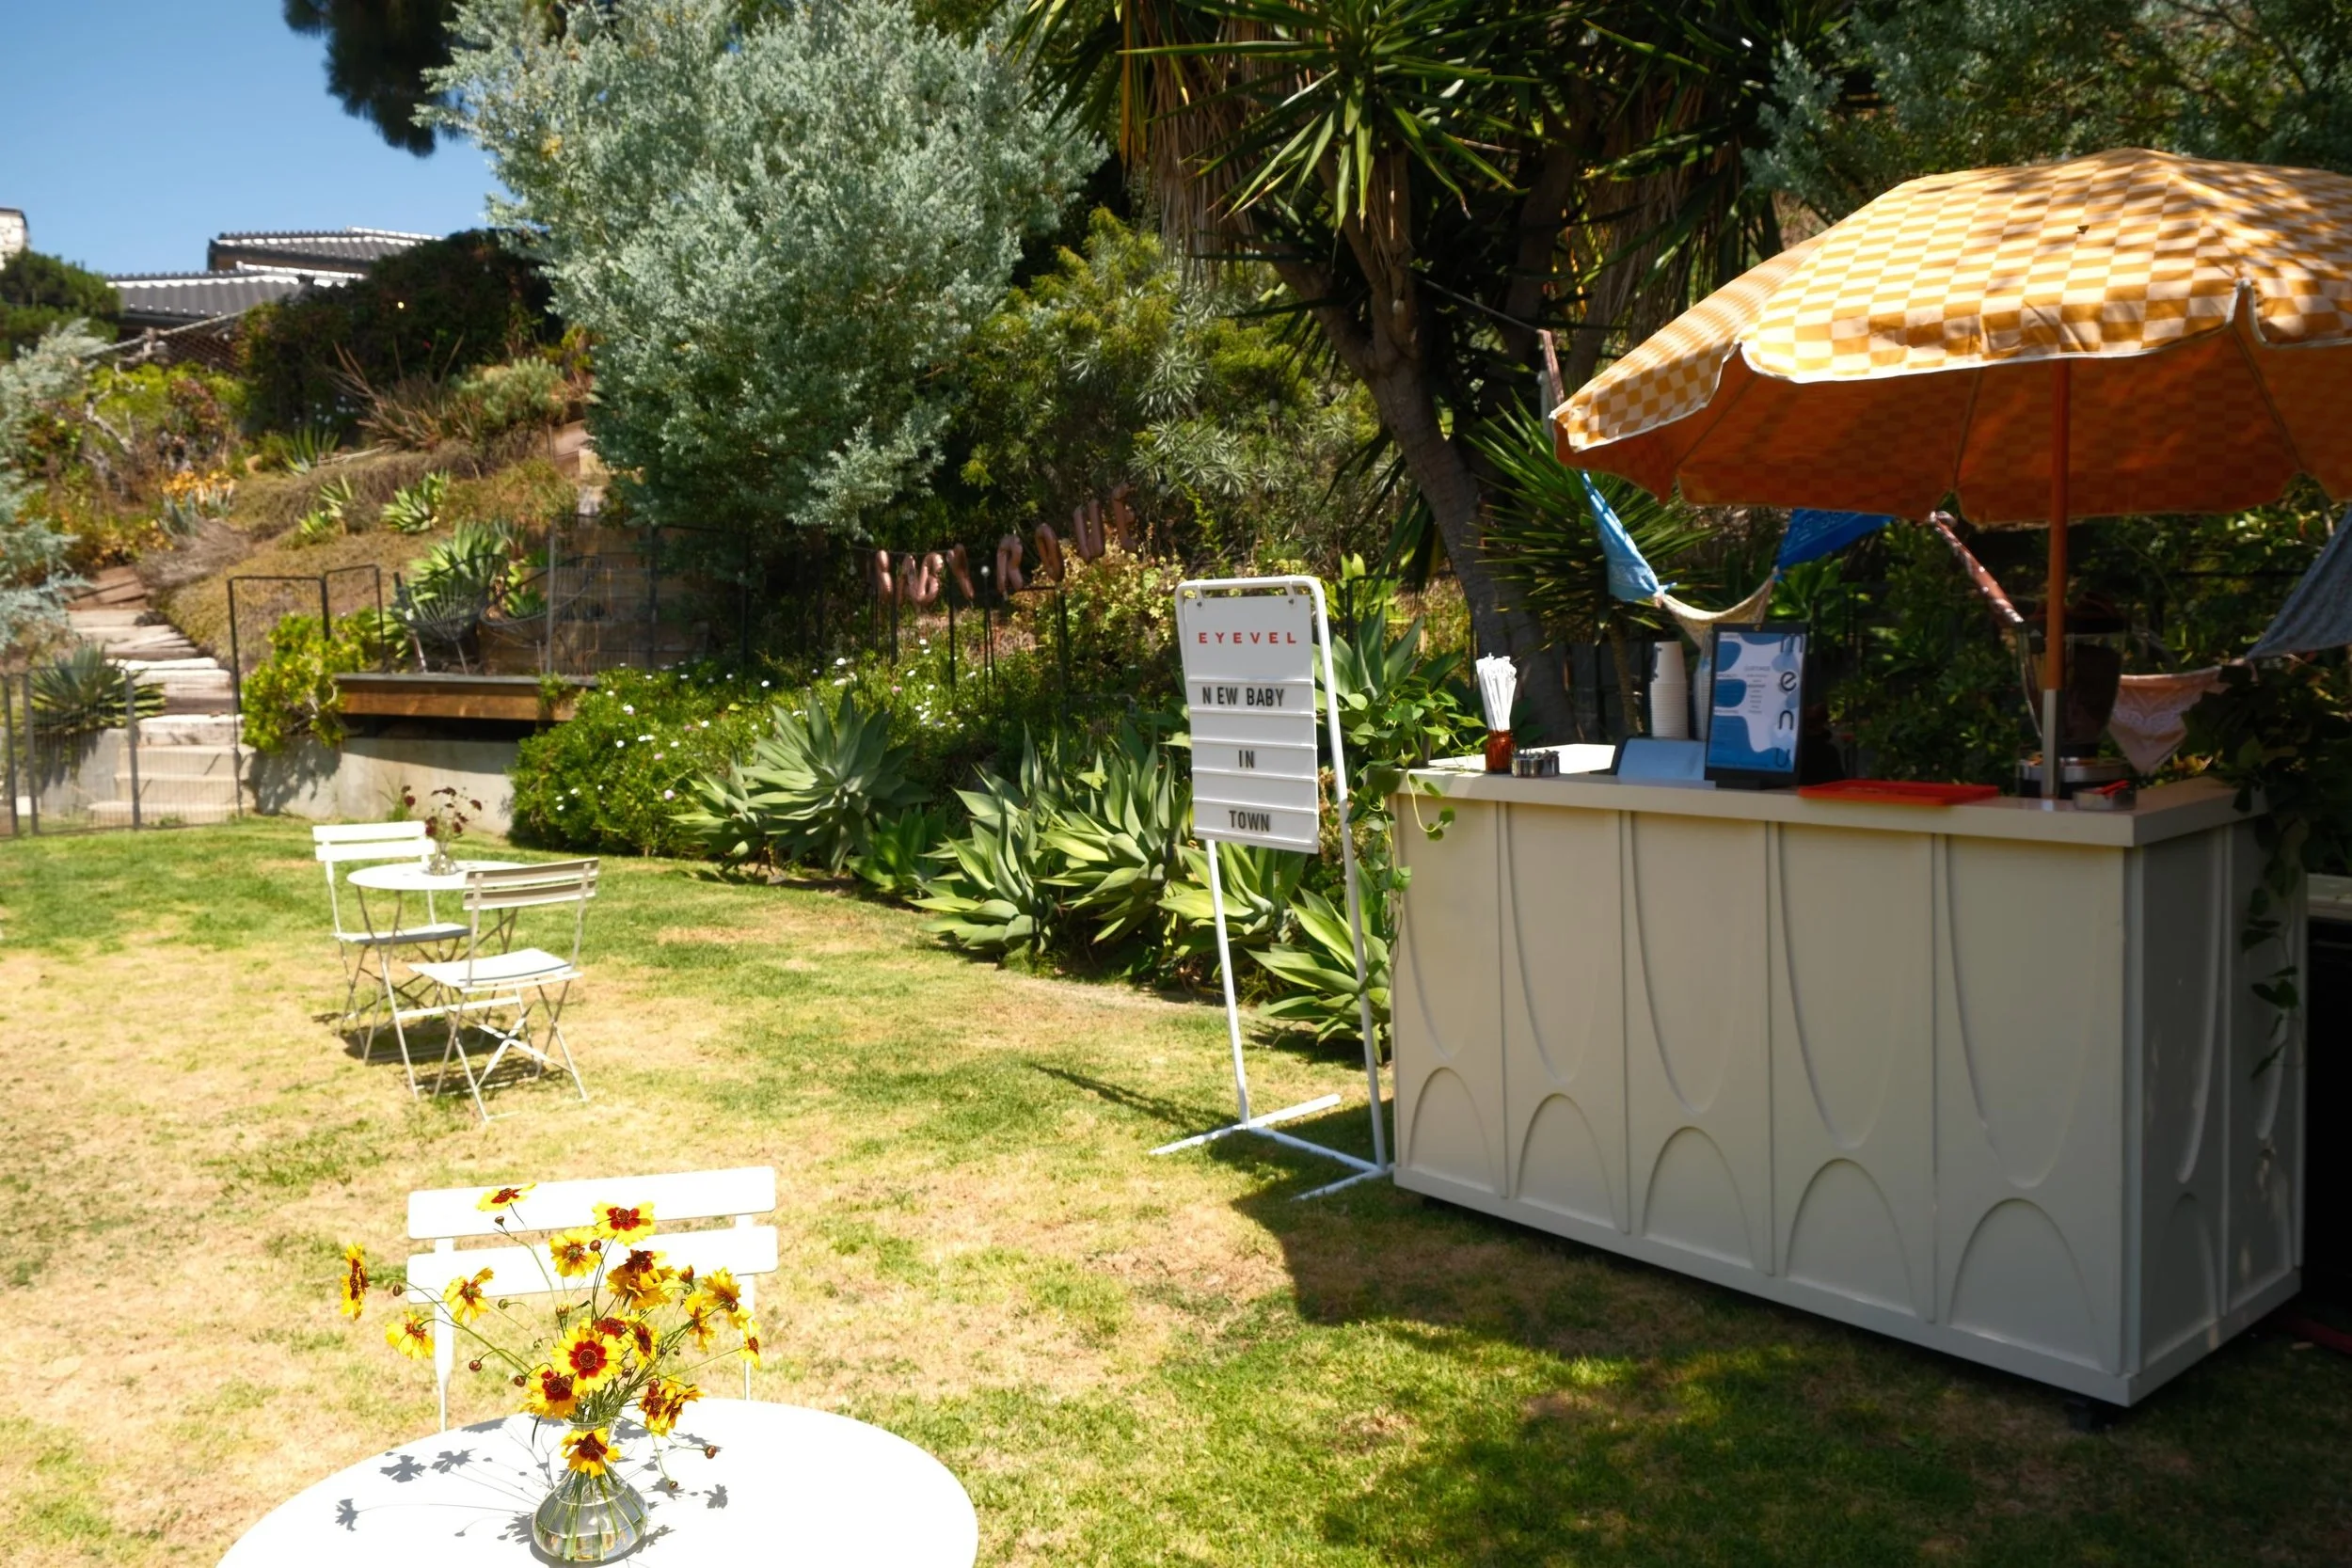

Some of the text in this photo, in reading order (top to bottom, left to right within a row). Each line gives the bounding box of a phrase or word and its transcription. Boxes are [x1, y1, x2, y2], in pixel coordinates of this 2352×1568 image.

[1198, 631, 1296, 644] EYEVEL
[1201, 686, 1285, 707] NEW BABY
[1775, 632, 1804, 768] menu
[1238, 750, 1255, 768] IN
[1228, 810, 1270, 832] TOWN
